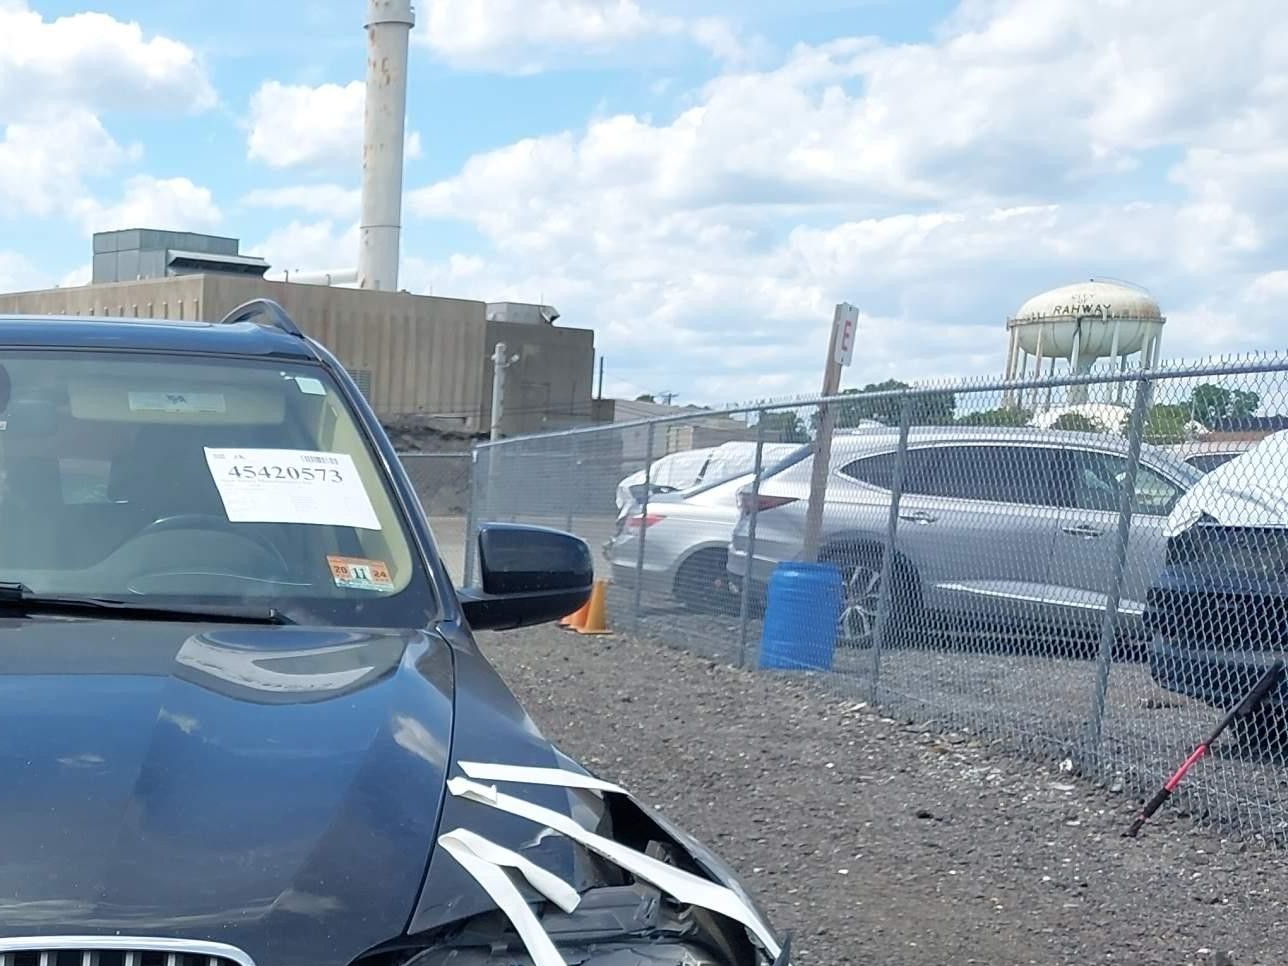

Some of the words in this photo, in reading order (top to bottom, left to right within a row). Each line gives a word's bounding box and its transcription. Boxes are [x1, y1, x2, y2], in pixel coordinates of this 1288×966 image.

[1053, 304, 1111, 314] RAHWAY
[228, 465, 343, 483] 45420573
[333, 565, 348, 574] 20
[353, 567, 369, 580] 11
